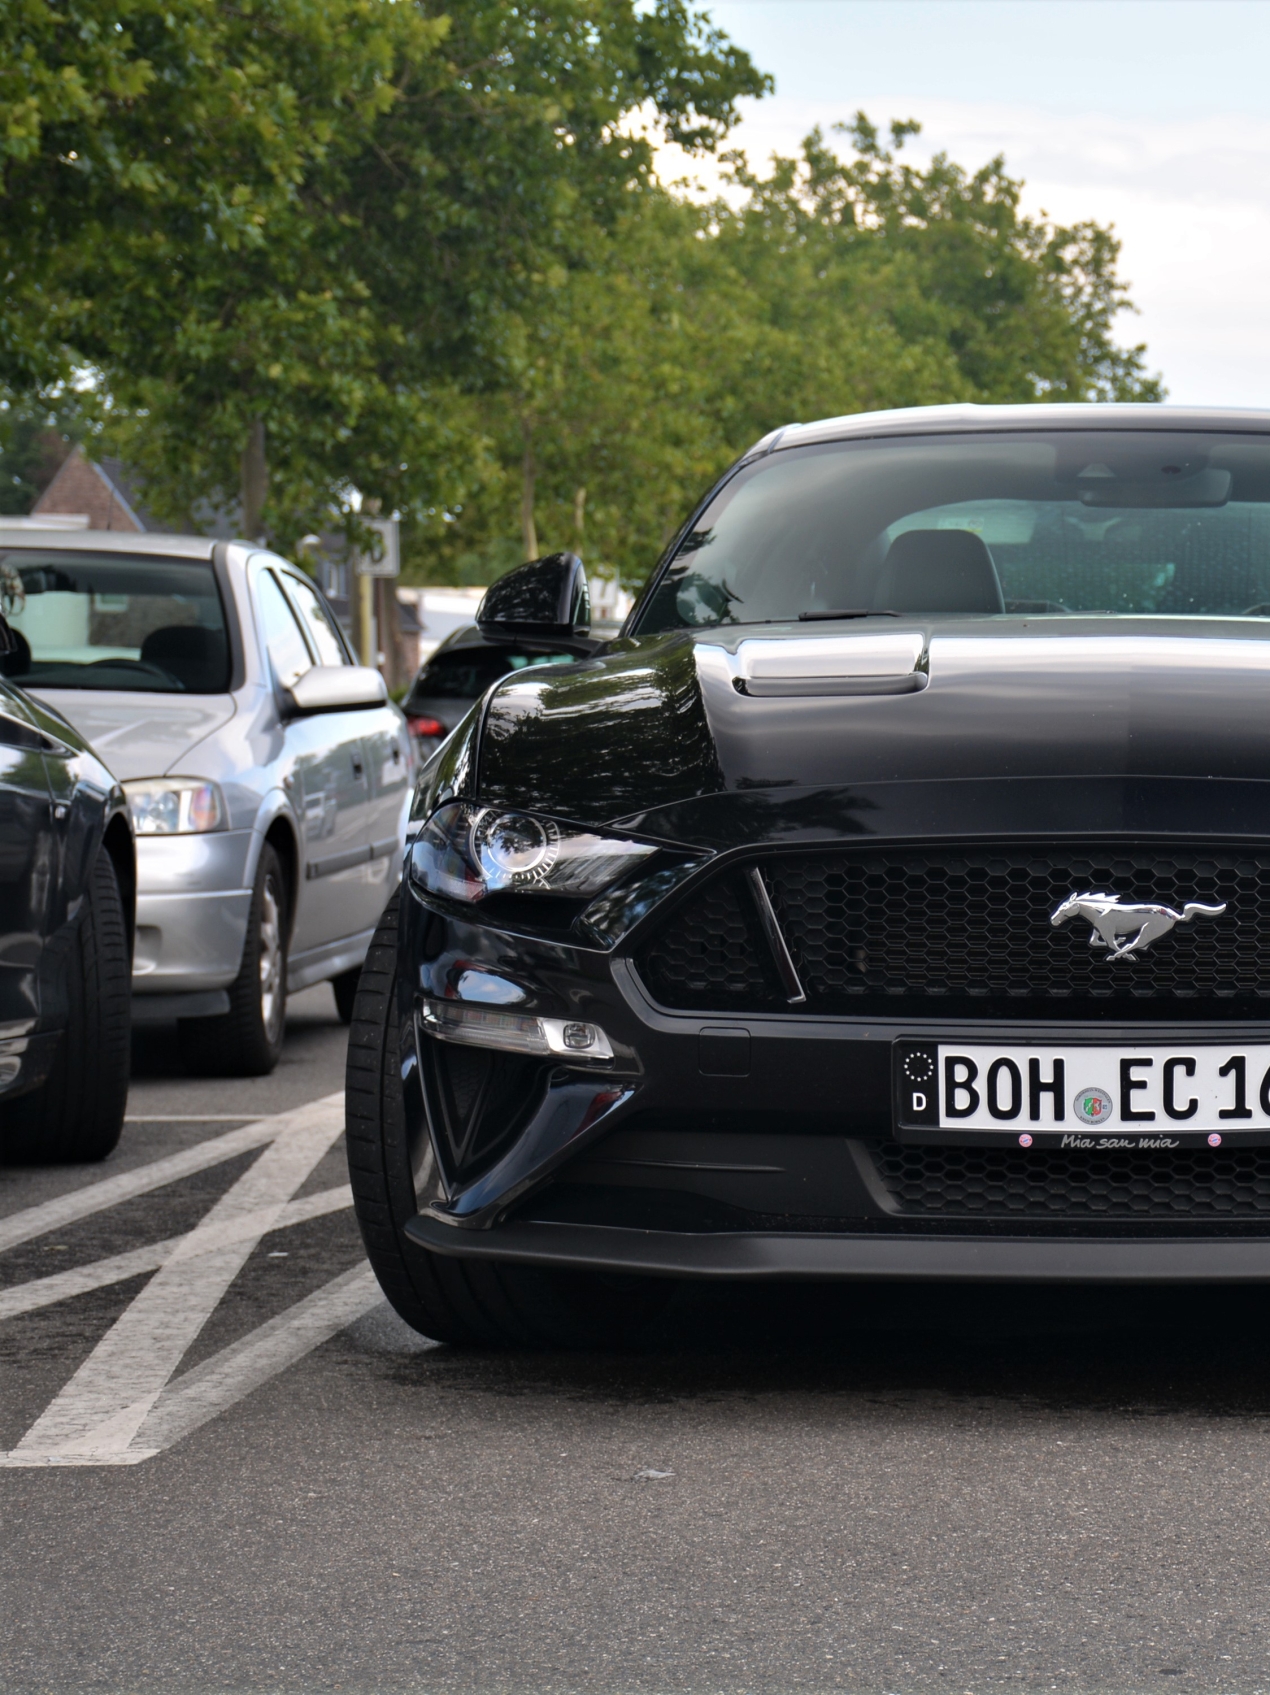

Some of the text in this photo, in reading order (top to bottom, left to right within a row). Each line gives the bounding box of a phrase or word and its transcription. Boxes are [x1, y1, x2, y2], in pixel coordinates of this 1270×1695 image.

[944, 1055, 1065, 1122] BOH
[1119, 1056, 1199, 1122] EC
[912, 1092, 927, 1111] D
[1060, 1134, 1180, 1149] Mia san mia
